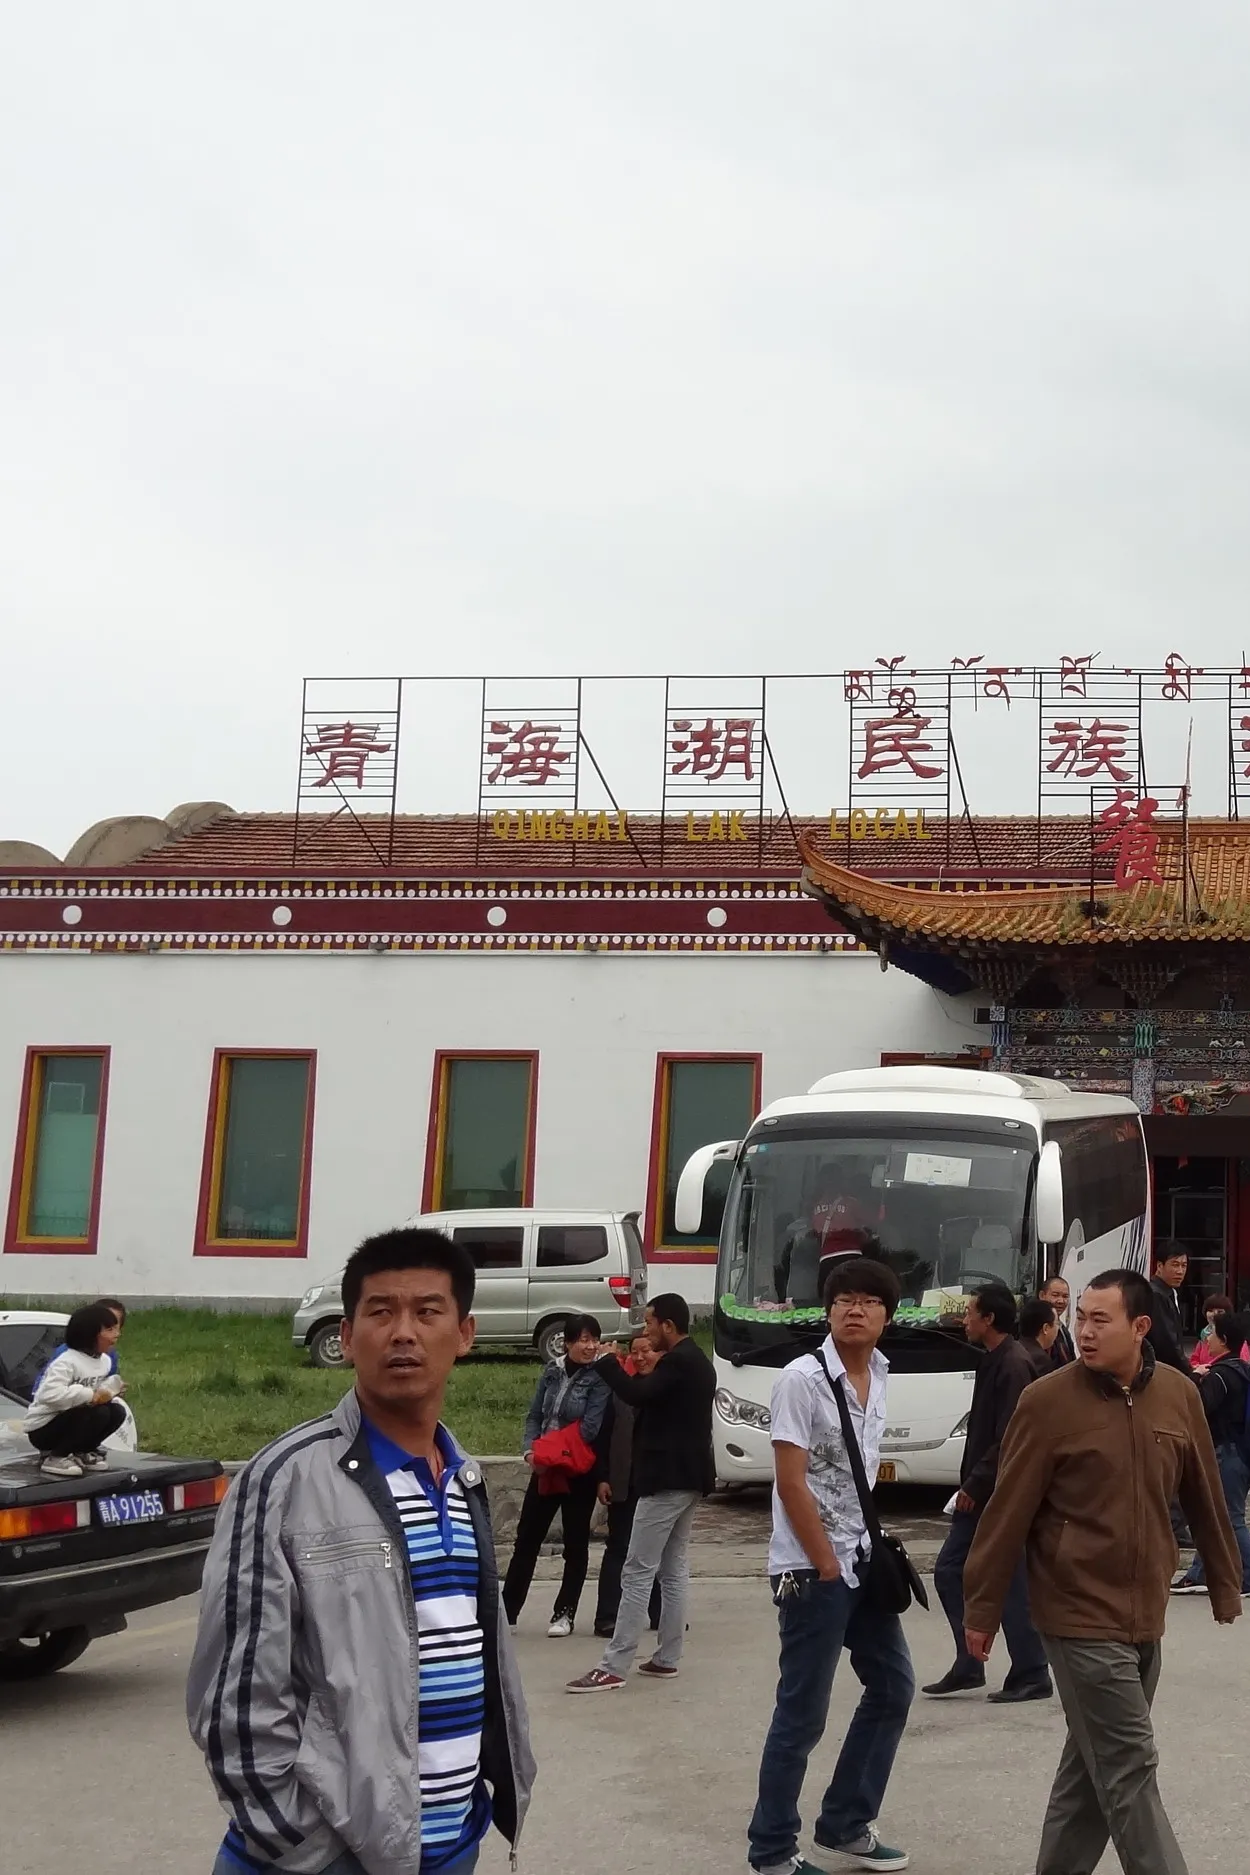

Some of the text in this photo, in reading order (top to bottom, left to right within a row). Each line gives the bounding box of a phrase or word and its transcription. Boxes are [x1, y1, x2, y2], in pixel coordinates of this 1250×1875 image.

[491, 809, 627, 841] QINGHAI
[686, 809, 748, 841] LAK
[830, 808, 932, 840] LOCAL
[882, 1427, 910, 1438] NG
